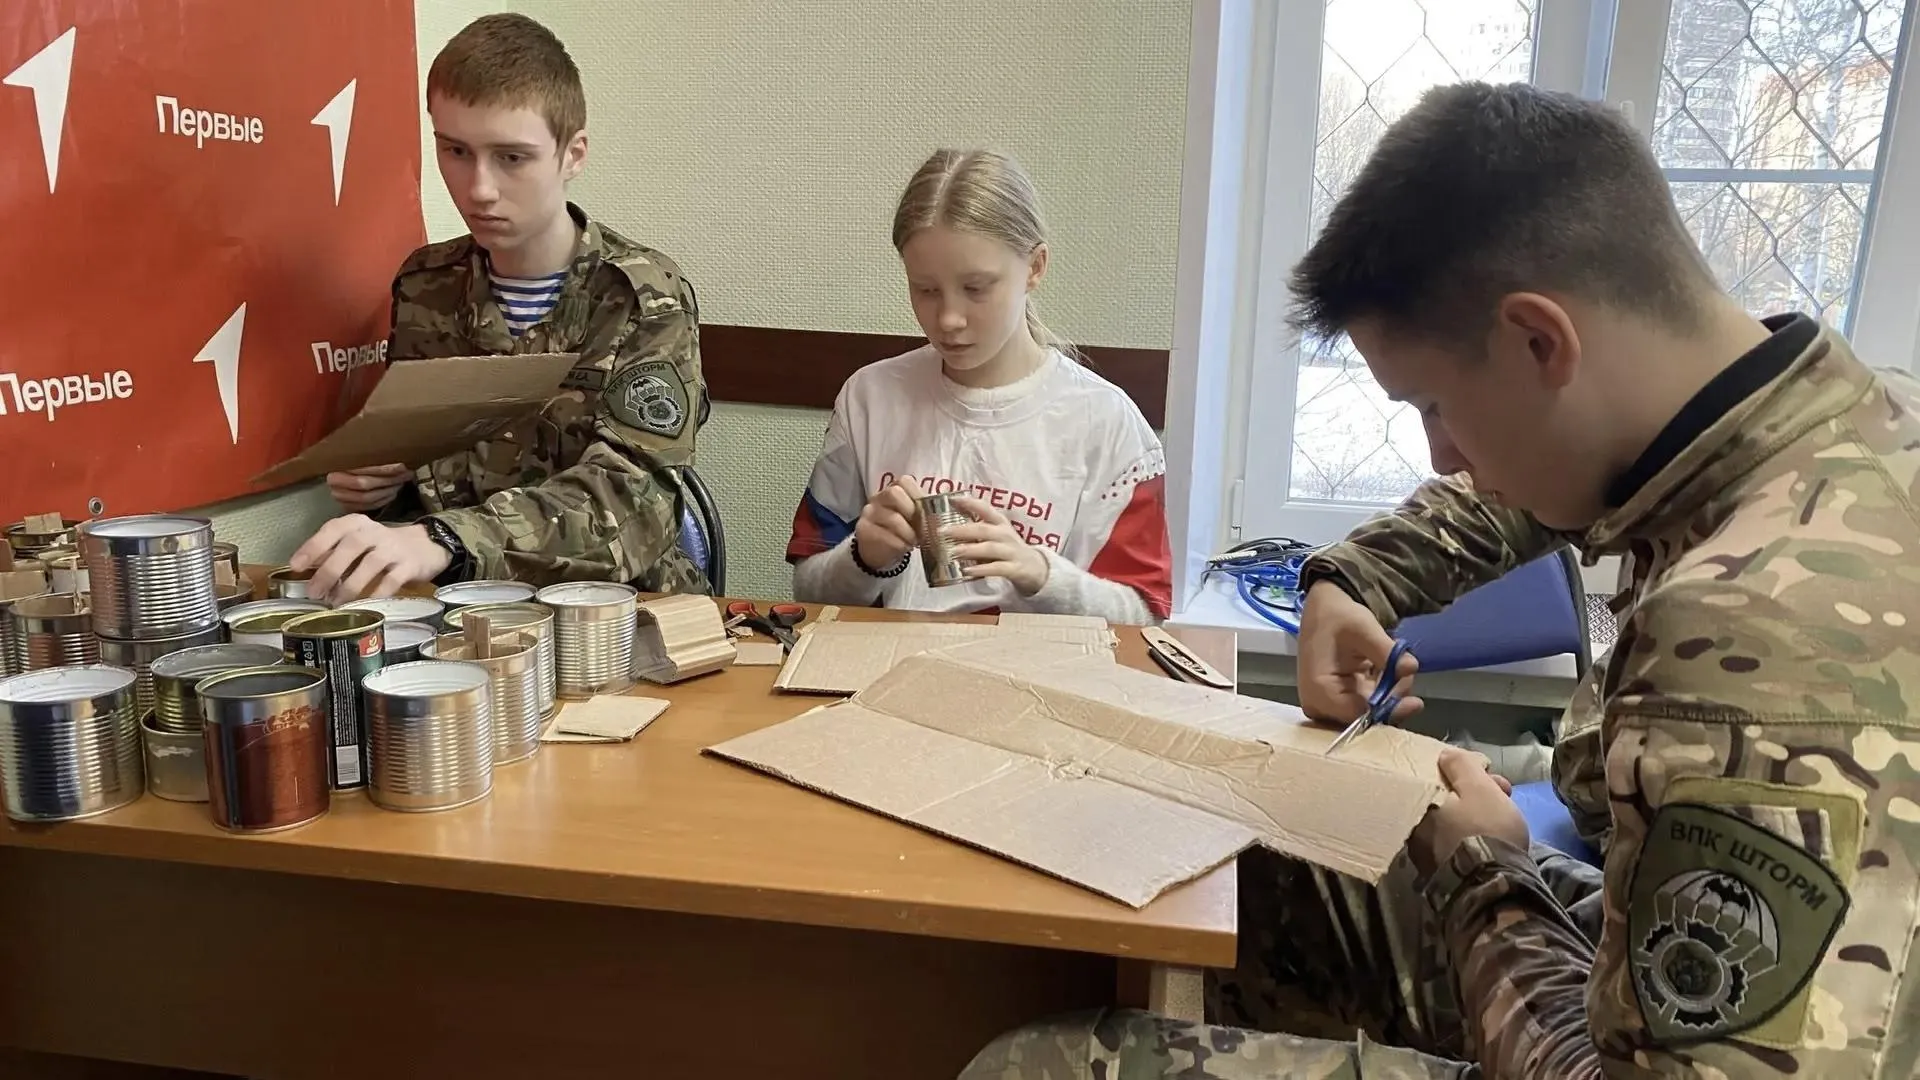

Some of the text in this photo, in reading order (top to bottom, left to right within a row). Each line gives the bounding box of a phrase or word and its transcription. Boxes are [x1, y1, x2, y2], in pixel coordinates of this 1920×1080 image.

[156, 95, 264, 148] Первые
[311, 340, 388, 379] Первые
[627, 364, 666, 378] ШТОРМ
[0, 370, 133, 422] Первые
[879, 472, 1052, 520] ВЛОТЕРЫ
[1671, 820, 1827, 911] ВПК ШТОРМ
